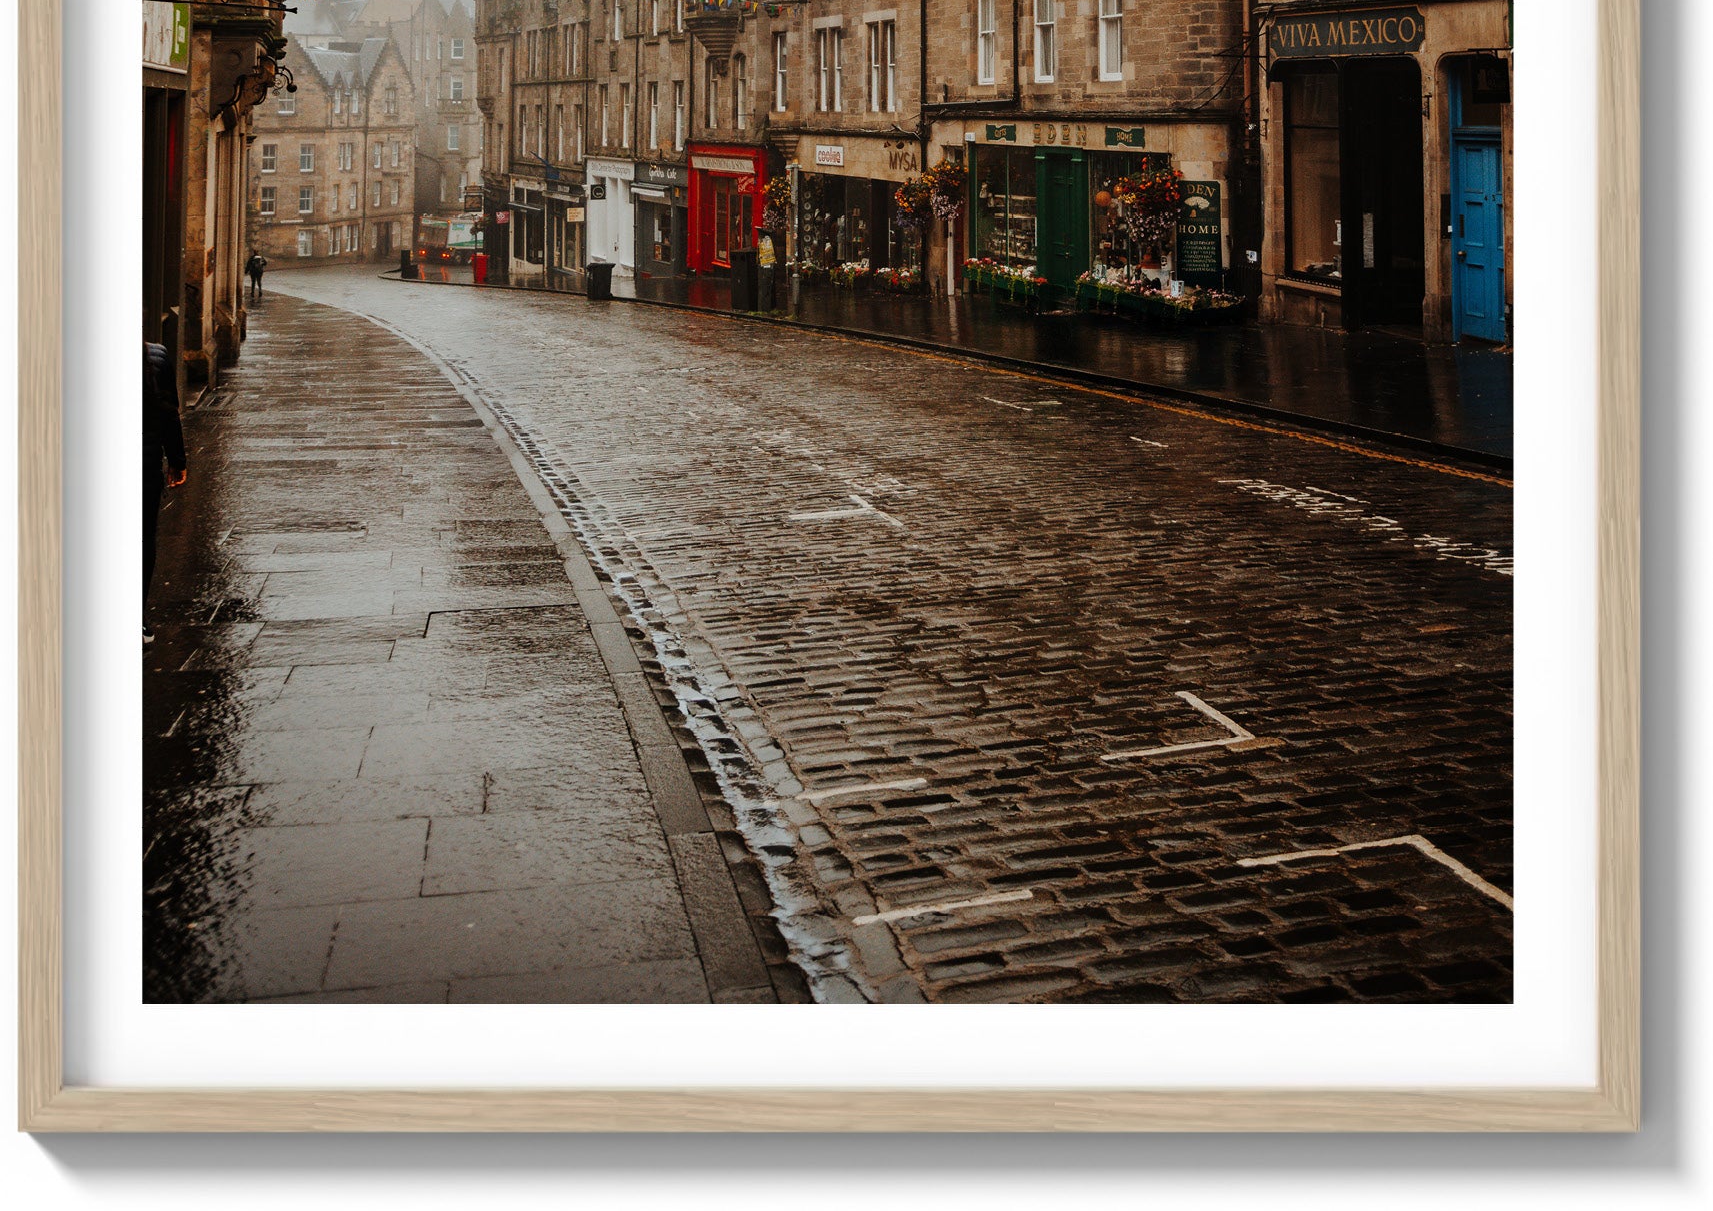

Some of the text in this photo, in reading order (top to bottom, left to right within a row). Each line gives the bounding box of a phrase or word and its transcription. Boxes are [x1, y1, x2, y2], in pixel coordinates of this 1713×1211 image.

[1277, 22, 1322, 48] VIVA
[1326, 16, 1417, 46] MEXICO
[1033, 123, 1087, 146] EDEN
[1116, 131, 1133, 143] HOME
[888, 151, 918, 172] MYSA
[666, 168, 677, 179] Cafe
[1187, 183, 1216, 198] DEN
[1179, 224, 1219, 234] HOME
